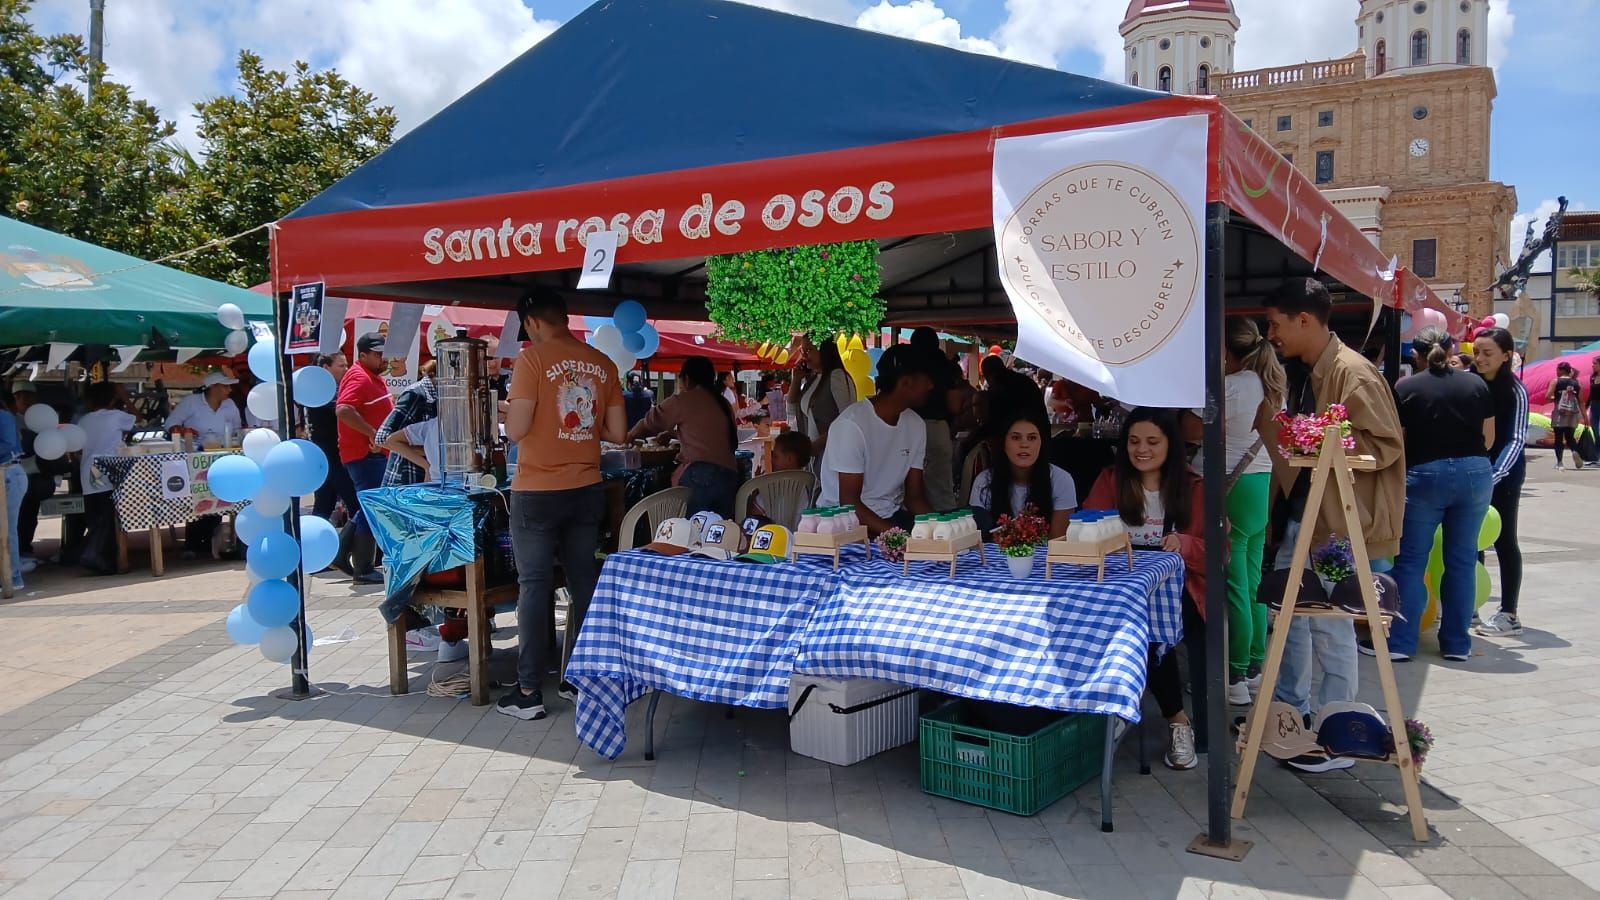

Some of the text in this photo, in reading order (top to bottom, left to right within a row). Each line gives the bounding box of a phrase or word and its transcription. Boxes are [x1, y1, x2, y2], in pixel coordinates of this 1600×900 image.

[678, 192, 746, 240] de
[761, 180, 896, 232] osos
[1019, 177, 1173, 245] GORRAS QUE TE CUBREN
[591, 248, 607, 273] 2
[1040, 227, 1148, 252] SABOR Y
[1051, 259, 1137, 281] ESTILO
[1056, 318, 1085, 342] QUE
[1090, 337, 1105, 349] TE
[1112, 269, 1175, 348] DESCUBREN
